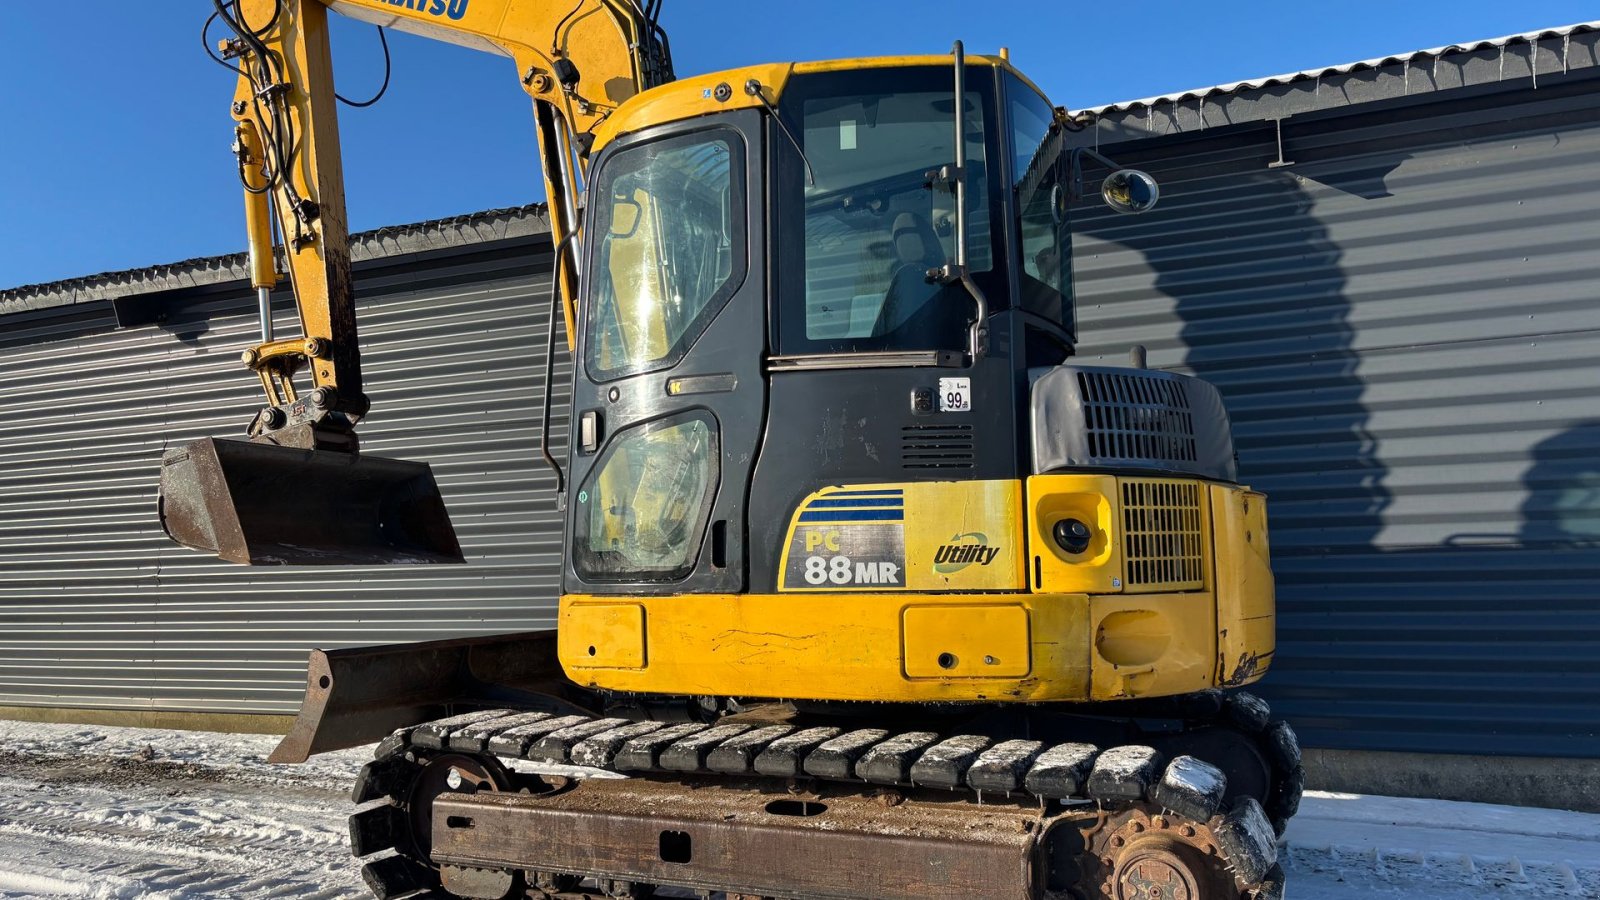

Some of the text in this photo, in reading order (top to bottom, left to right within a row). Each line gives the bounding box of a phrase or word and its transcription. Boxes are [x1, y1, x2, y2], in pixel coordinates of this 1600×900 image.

[947, 392, 962, 408] 99
[805, 531, 840, 551] PC
[933, 544, 1000, 566] Utility
[804, 555, 898, 585] 88MR
